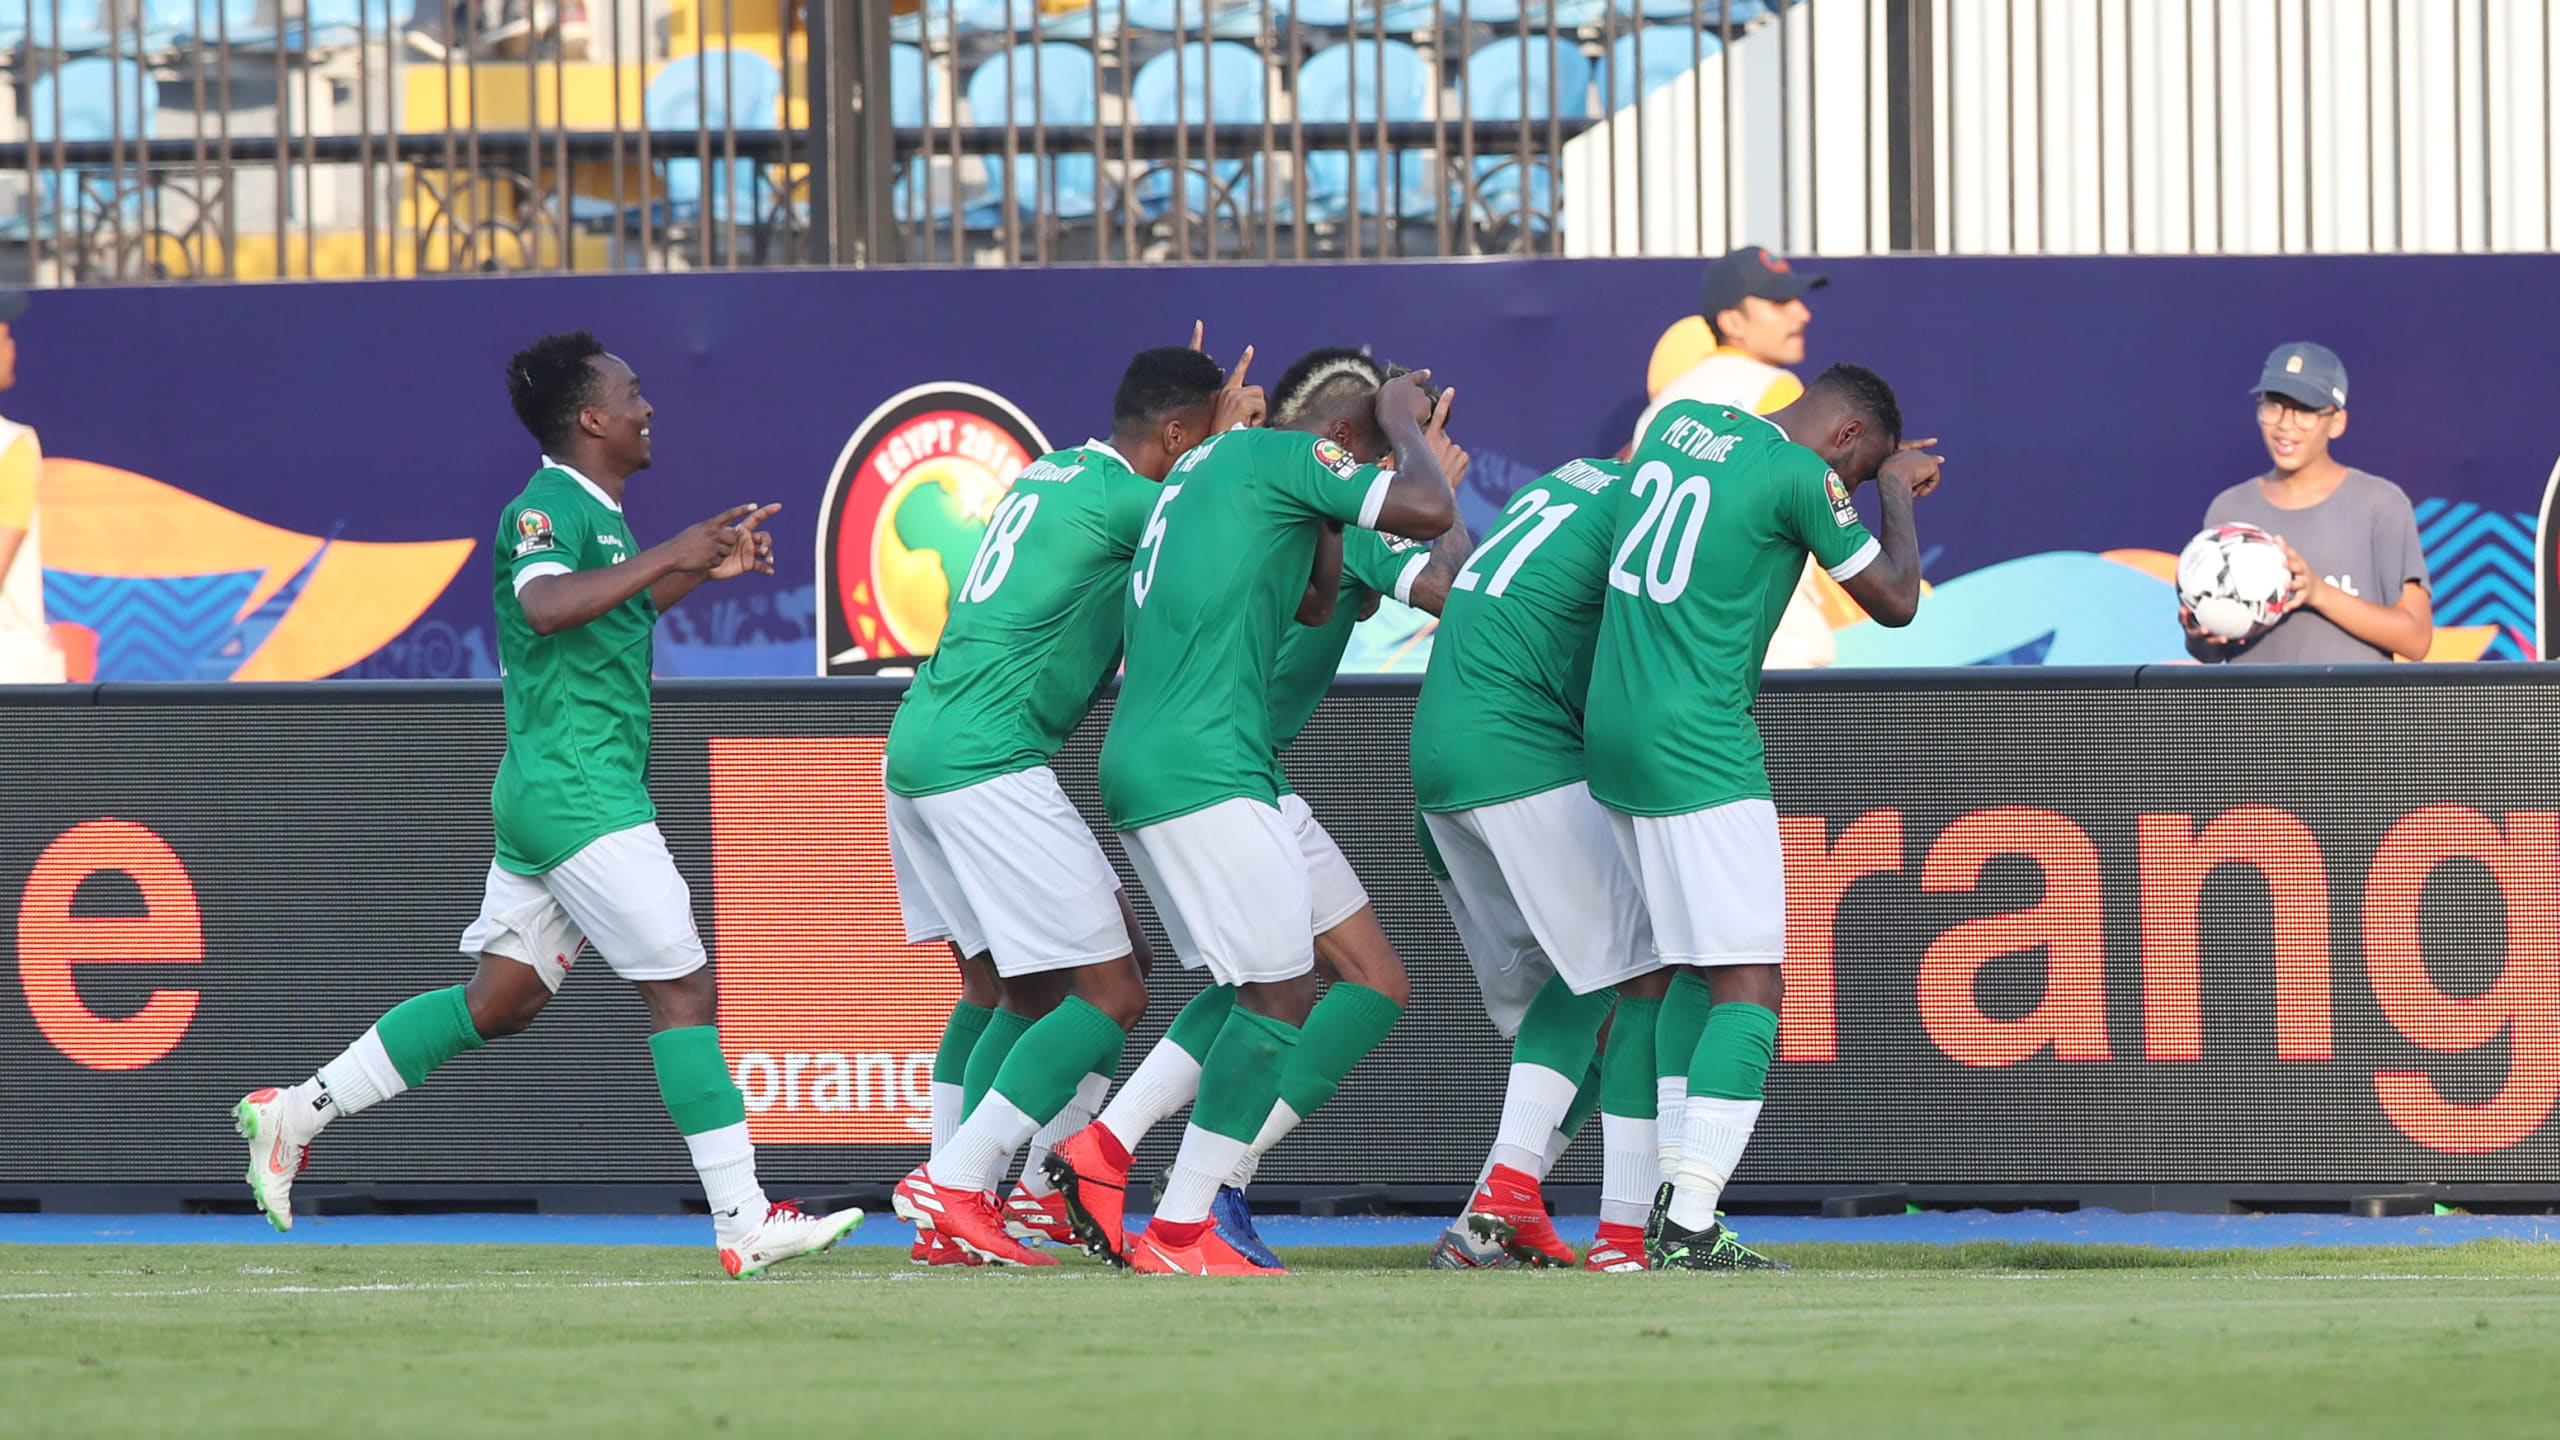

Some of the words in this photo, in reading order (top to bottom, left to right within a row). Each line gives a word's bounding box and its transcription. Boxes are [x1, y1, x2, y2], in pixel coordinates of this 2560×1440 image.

[873, 418, 954, 485] EGYPT
[958, 491, 1039, 603] 18
[1133, 480, 1185, 609] 5
[1452, 488, 1579, 598] 21
[1609, 461, 1711, 604] 20
[17, 816, 205, 1070] e
